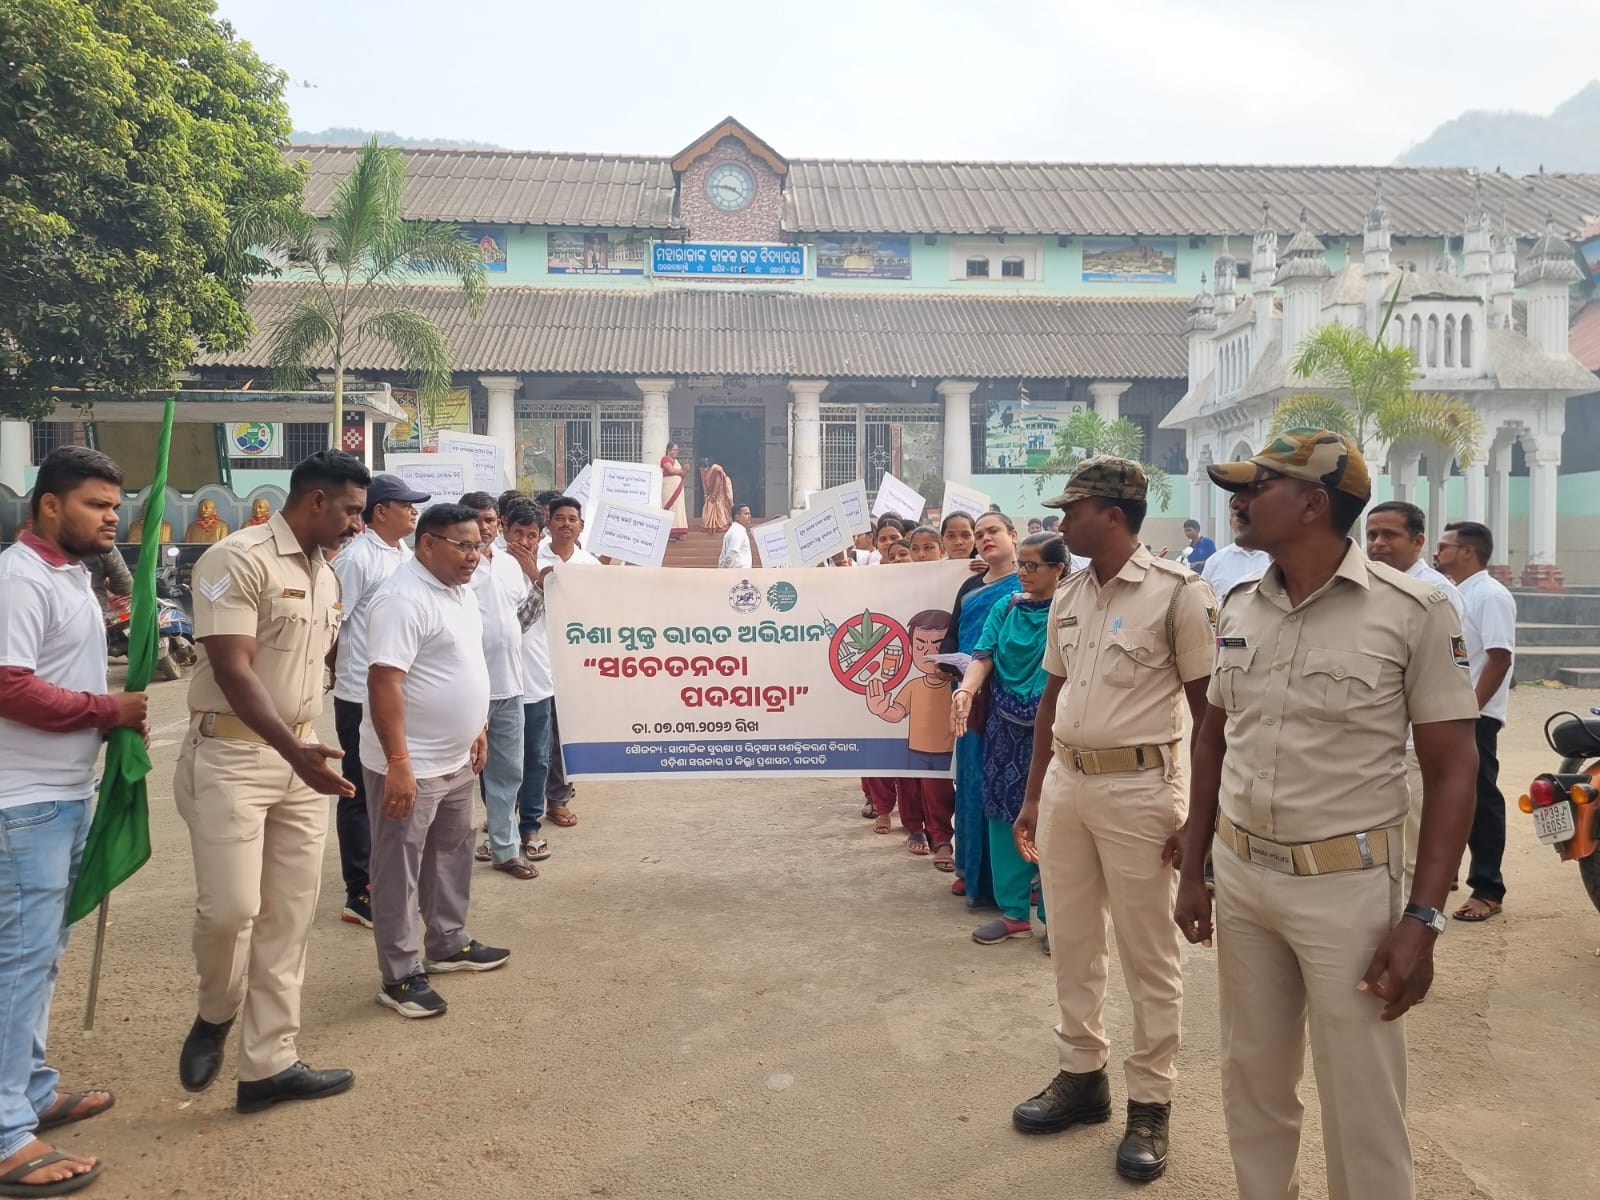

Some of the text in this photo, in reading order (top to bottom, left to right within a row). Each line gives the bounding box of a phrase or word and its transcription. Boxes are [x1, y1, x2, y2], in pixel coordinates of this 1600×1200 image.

[710, 249, 737, 263] ବାଳକ
[760, 247, 800, 265] ବିଦ୍ୟାଳୟ
[566, 620, 825, 651] ନିଶା ମୁକ୍ତ ଭାରତ ଅଭିଯାନ
[583, 656, 748, 678] “ସଚେତନତା
[680, 685, 809, 713] ପଦଯାତ୍ରା”
[631, 721, 651, 734] ତା.
[735, 718, 759, 732] ରିଖ
[668, 744, 706, 754] ସାମାଜିକ
[708, 745, 734, 756] ସୁରକ୍ଷା
[735, 745, 743, 753] ଓ
[829, 742, 859, 753] ବିଭାଗ,
[688, 758, 723, 767] ସରକାର
[725, 758, 733, 766] ଓ
[734, 756, 755, 768] ଜିଲ୍ଲା
[793, 755, 827, 766] ଗଜପତି
